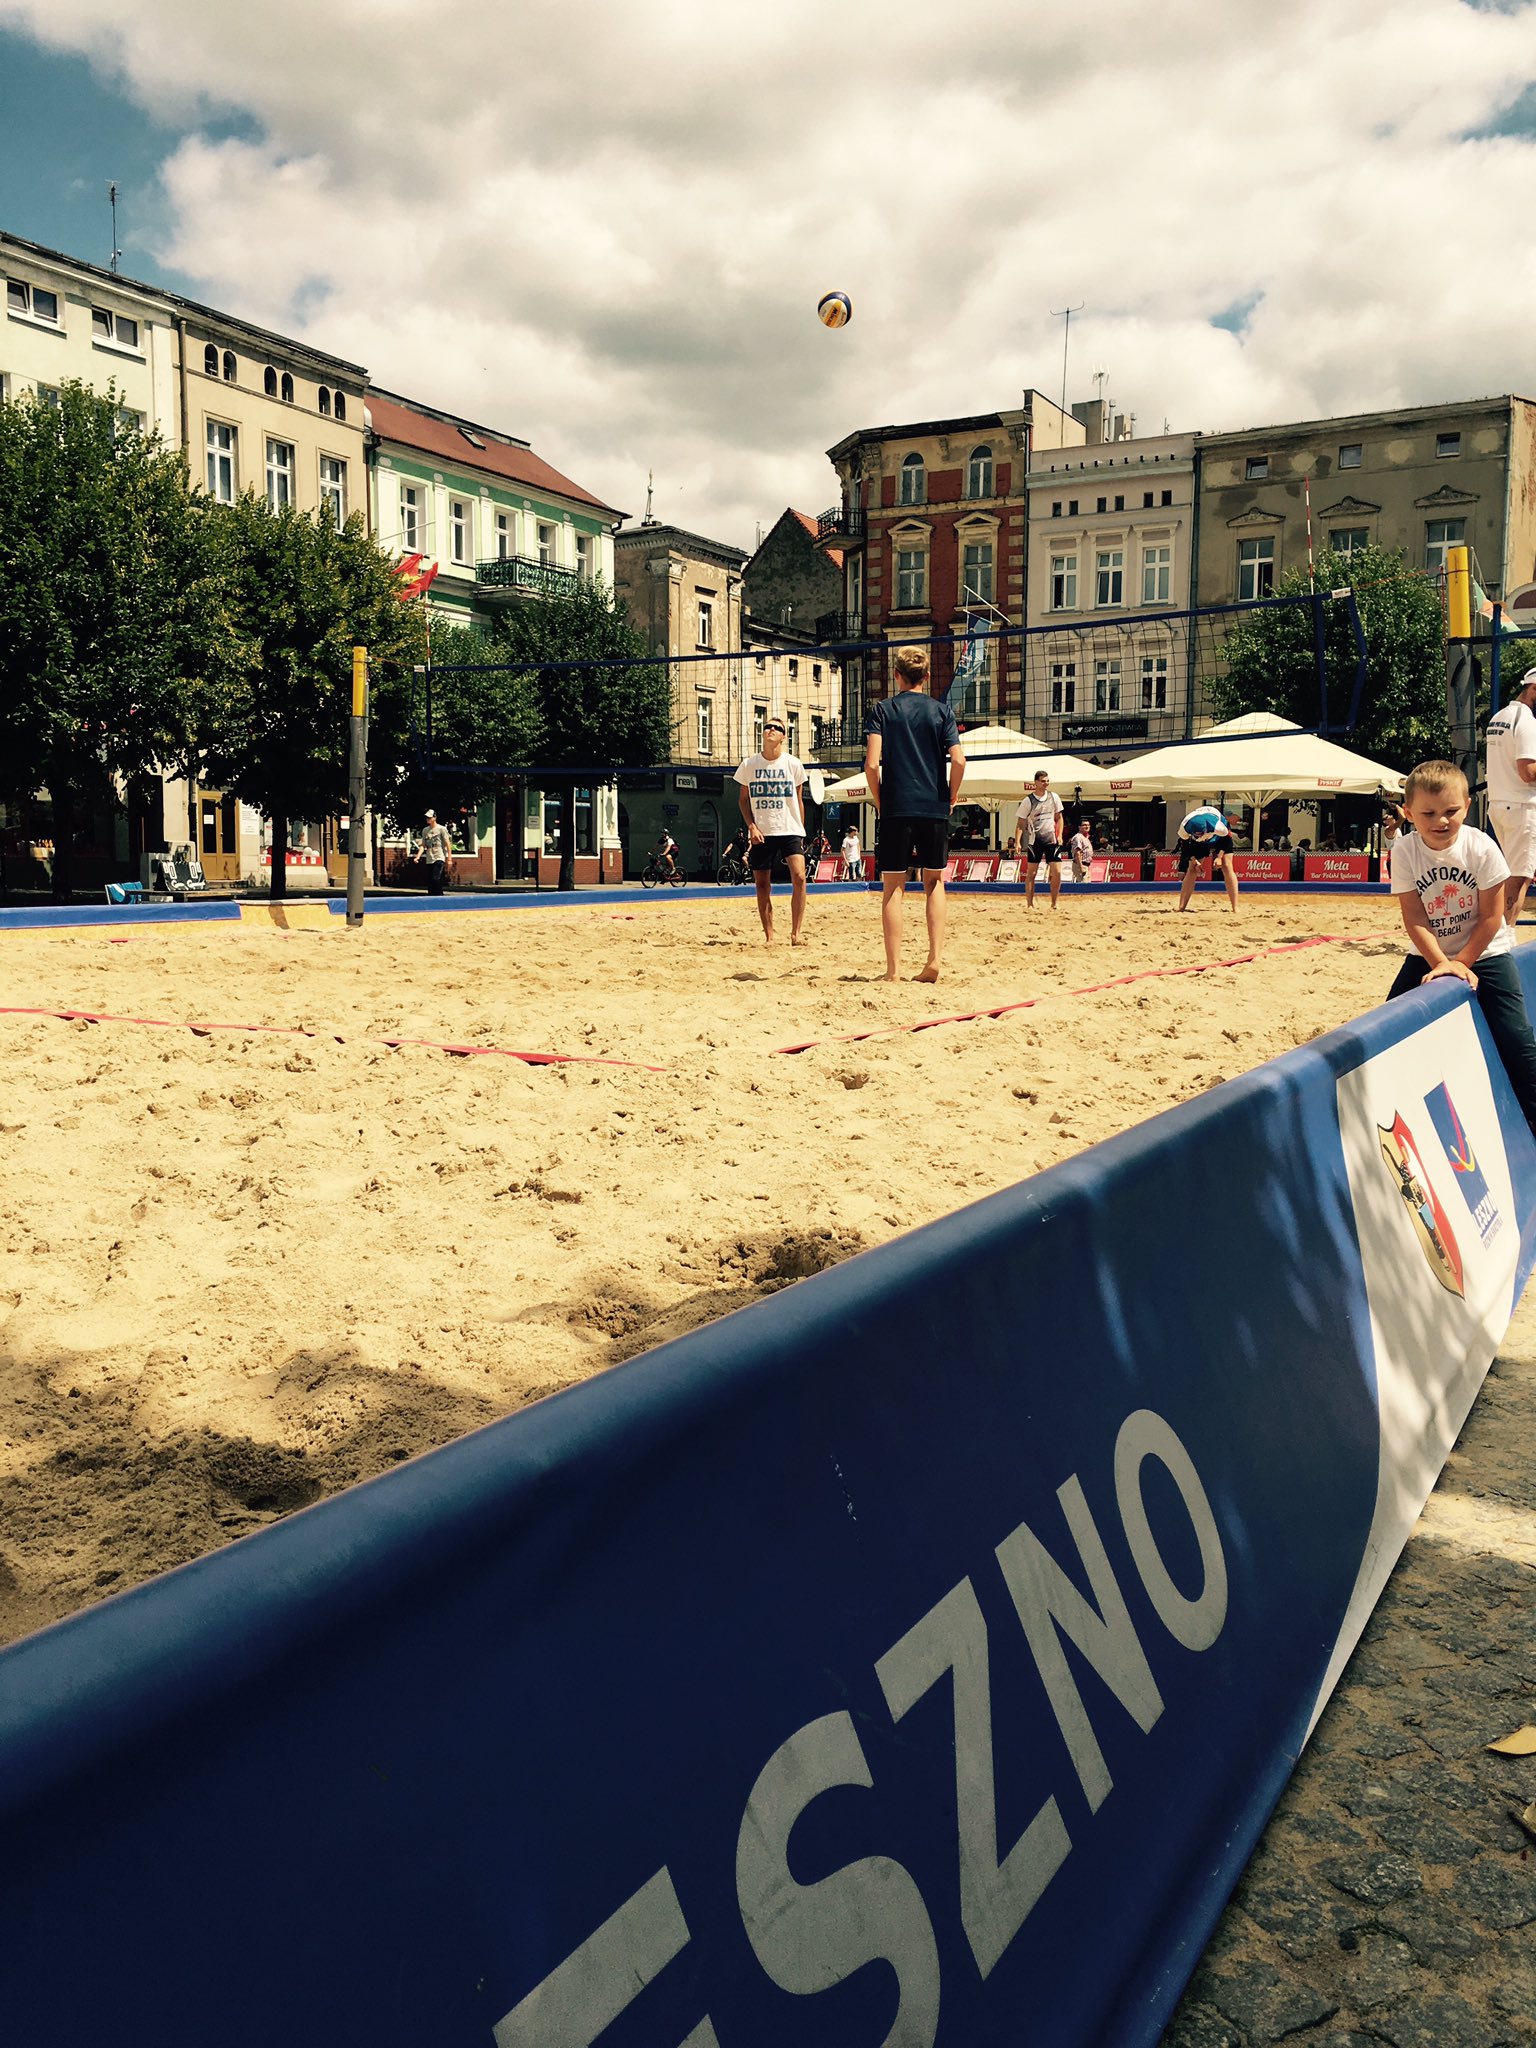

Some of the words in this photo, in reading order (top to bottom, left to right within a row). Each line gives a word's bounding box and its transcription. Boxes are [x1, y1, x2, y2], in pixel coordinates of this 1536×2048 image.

[755, 769, 785, 779] UNIA
[750, 785, 764, 796] TO
[766, 784, 793, 796] MY!
[848, 788, 866, 796] TYSKIE
[755, 800, 784, 810] 1938
[1110, 861, 1124, 870] eta
[1450, 911, 1472, 925] POINT
[1438, 925, 1461, 937] BEACH
